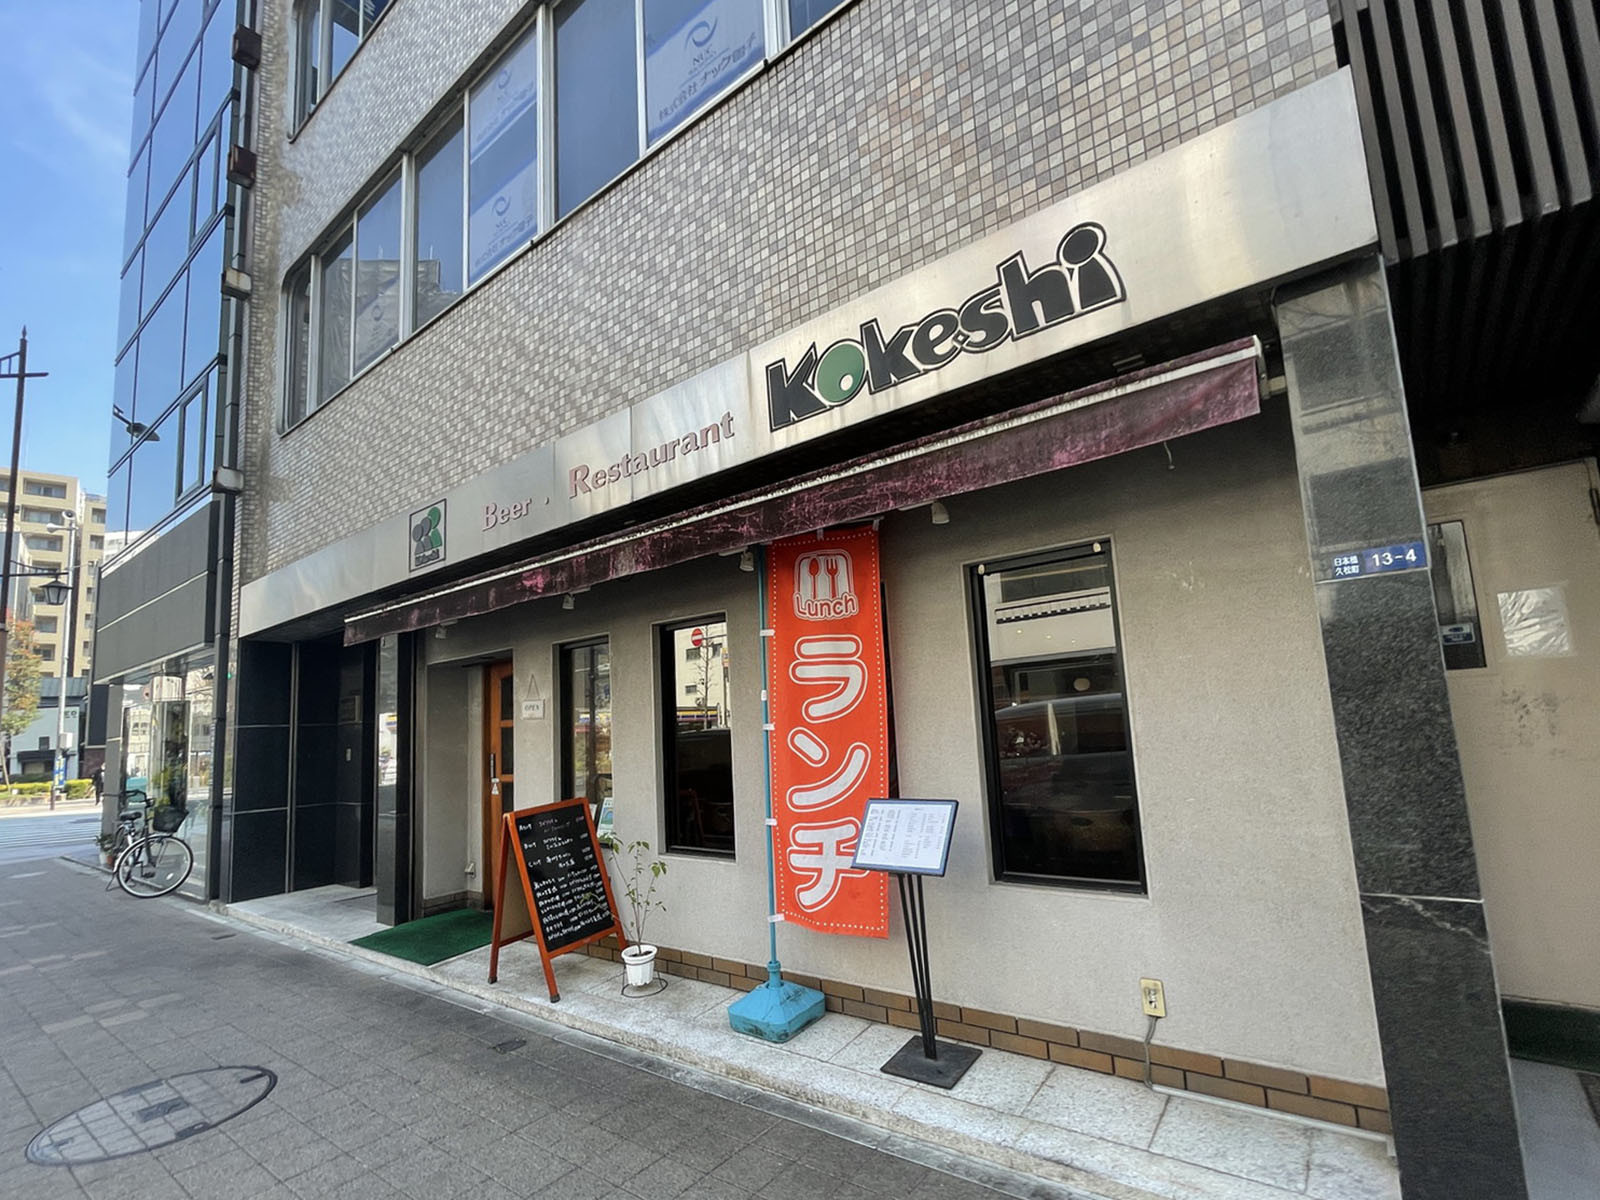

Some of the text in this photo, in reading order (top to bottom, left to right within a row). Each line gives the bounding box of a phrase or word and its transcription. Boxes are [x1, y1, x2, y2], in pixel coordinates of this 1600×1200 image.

[765, 221, 1127, 433] Kokeshi
[481, 411, 735, 532] Beer Restaurant
[795, 593, 857, 618] Lunch
[1372, 548, 1417, 567] 13-4
[787, 635, 870, 911] ランチ
